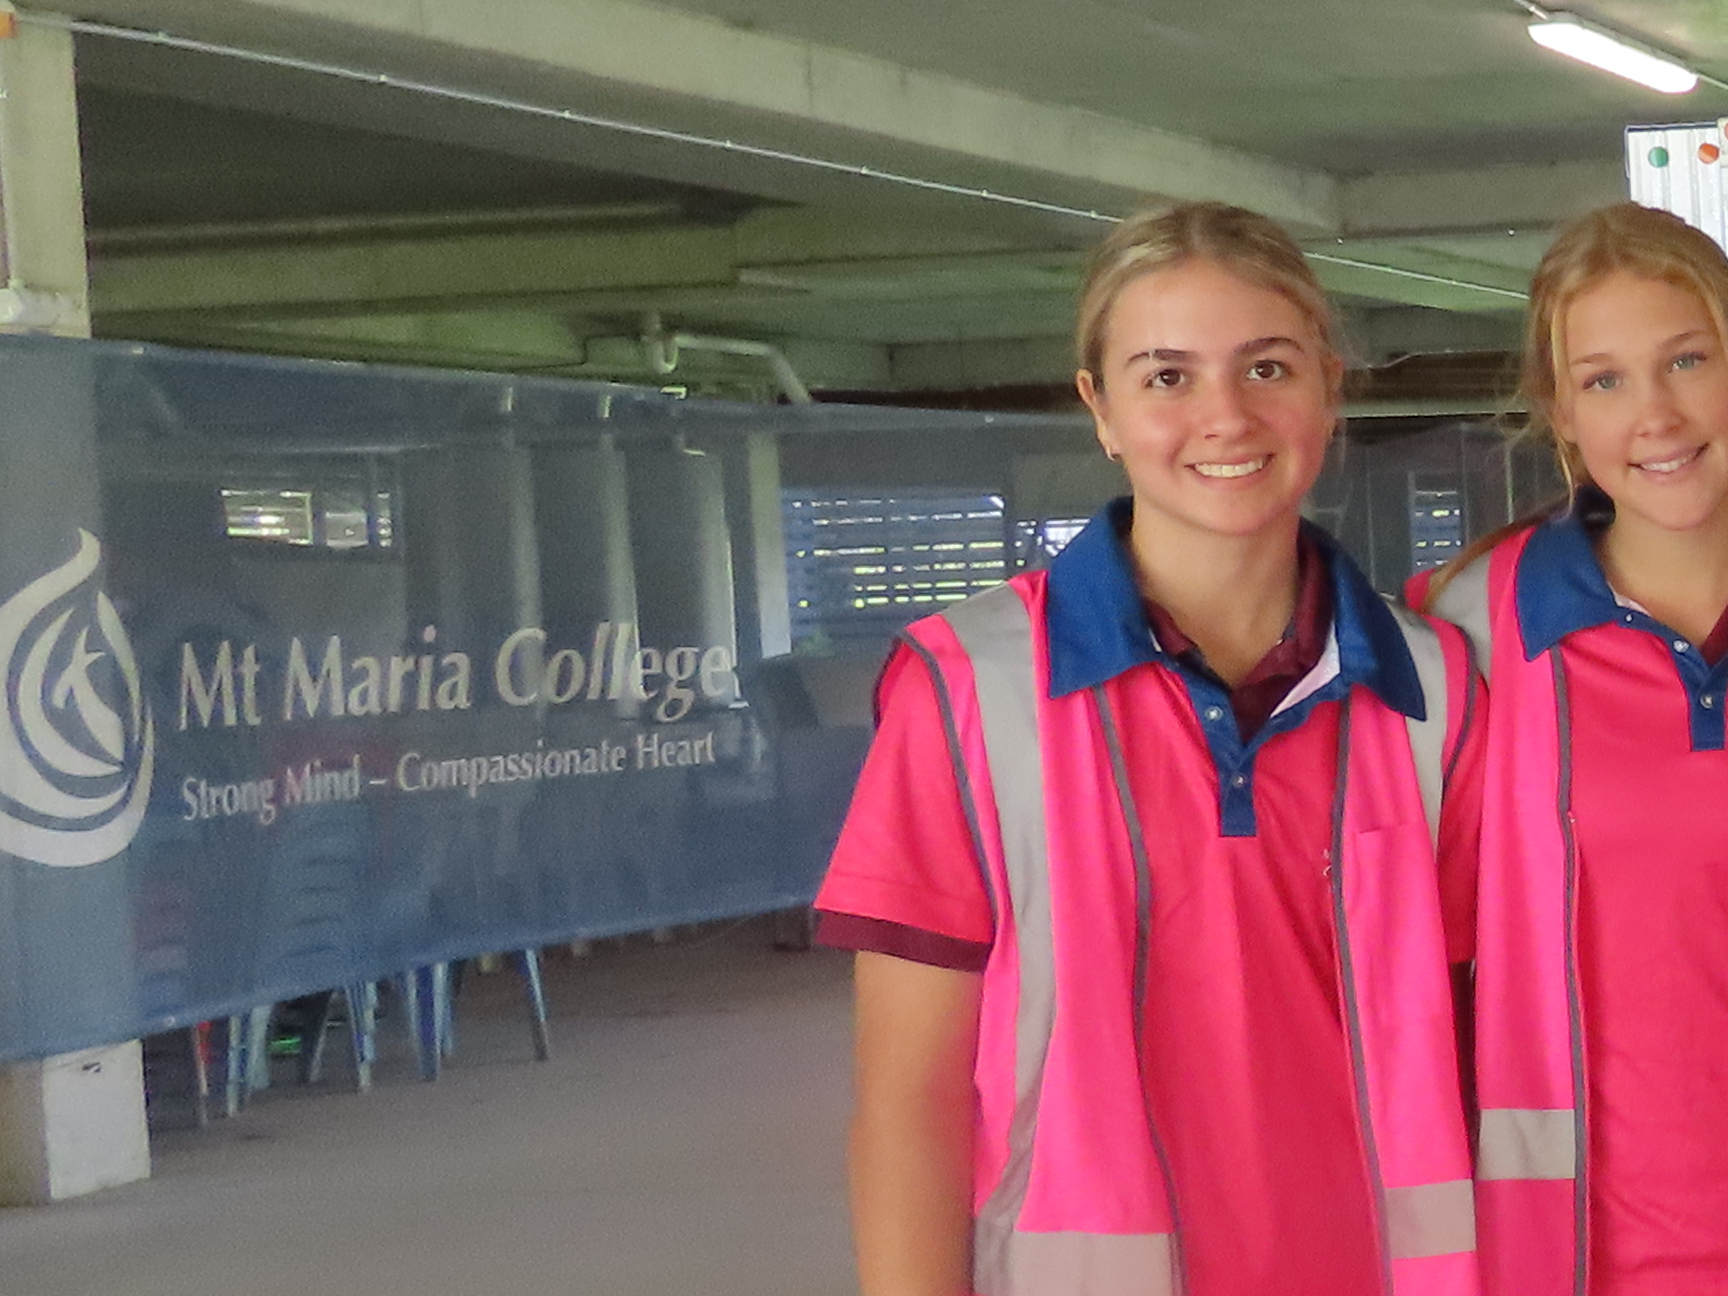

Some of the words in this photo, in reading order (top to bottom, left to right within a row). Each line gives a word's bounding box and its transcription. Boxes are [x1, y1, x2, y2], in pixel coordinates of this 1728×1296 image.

[179, 639, 262, 731] Mt
[284, 624, 471, 721] Maria
[495, 619, 736, 723] College
[182, 776, 277, 826] Strong
[285, 754, 361, 805] Mind
[397, 739, 628, 799] Compassionate
[634, 730, 716, 770] Heart
